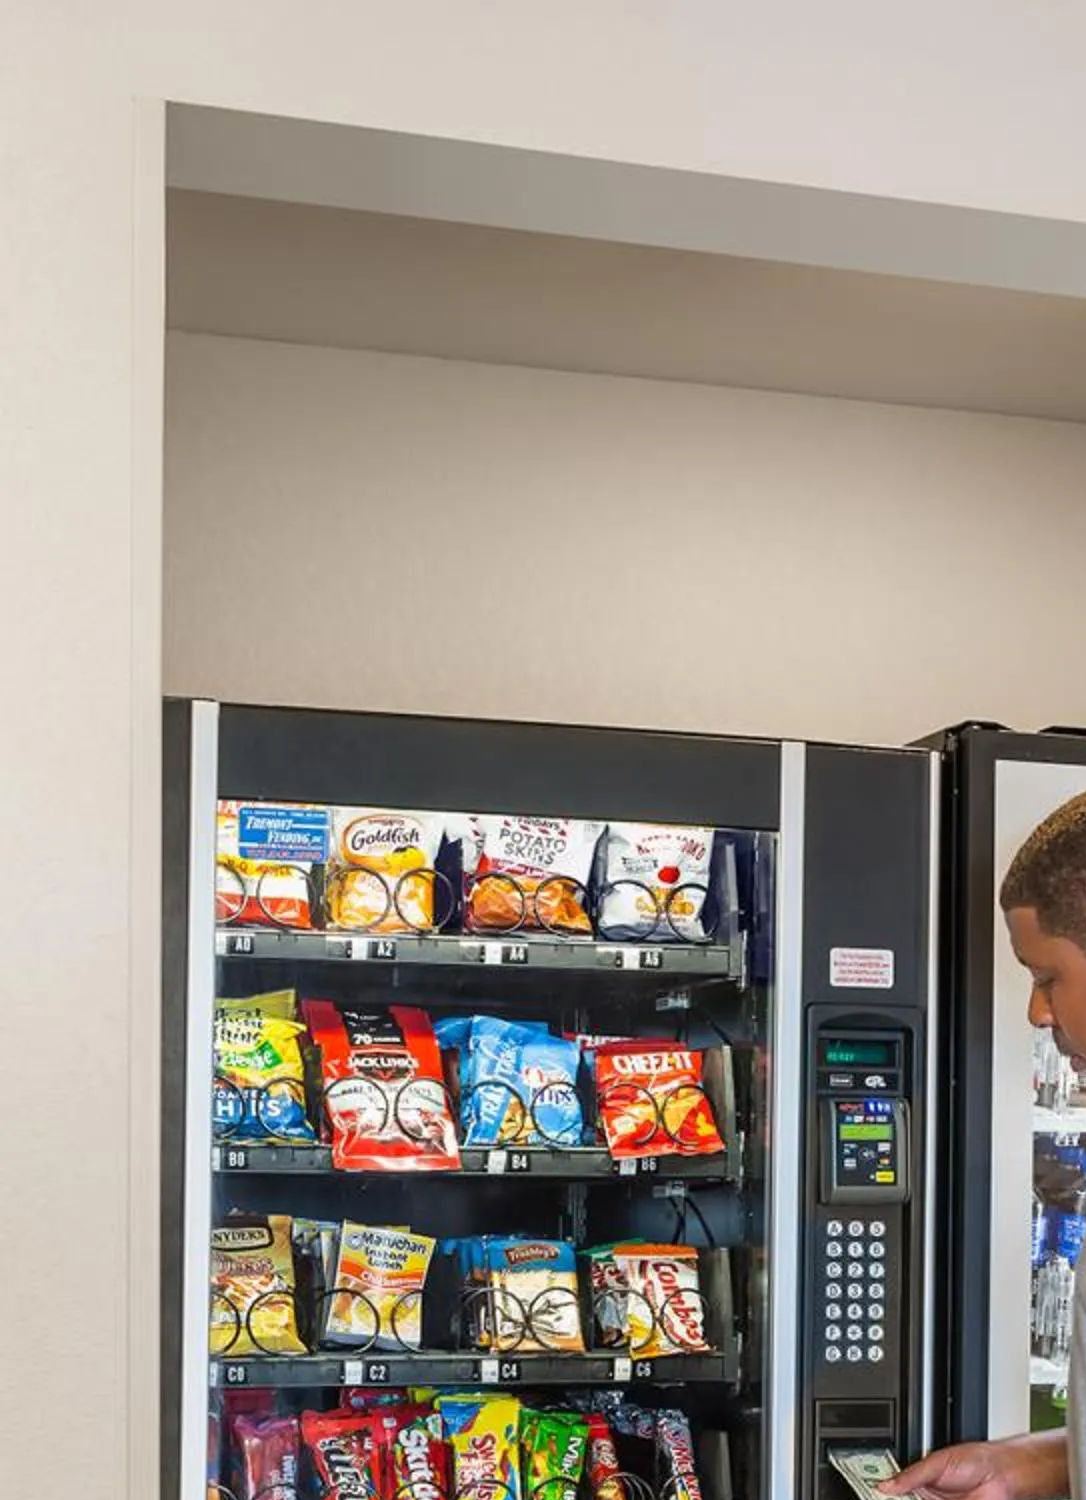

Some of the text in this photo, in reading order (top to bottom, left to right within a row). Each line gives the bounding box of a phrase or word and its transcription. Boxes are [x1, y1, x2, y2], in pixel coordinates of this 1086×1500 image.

[350, 828, 420, 851] Goldfish
[499, 828, 568, 853] POTATO
[503, 842, 556, 865] SKINS
[235, 938, 251, 951] A0
[377, 942, 392, 957] A2
[509, 946, 524, 961] A4
[228, 1151, 245, 1167] B0
[511, 1152, 527, 1169] B4
[652, 1262, 701, 1341] Combos
[227, 1365, 245, 1382] C0
[369, 1363, 386, 1380] C2
[501, 1362, 517, 1379] C4
